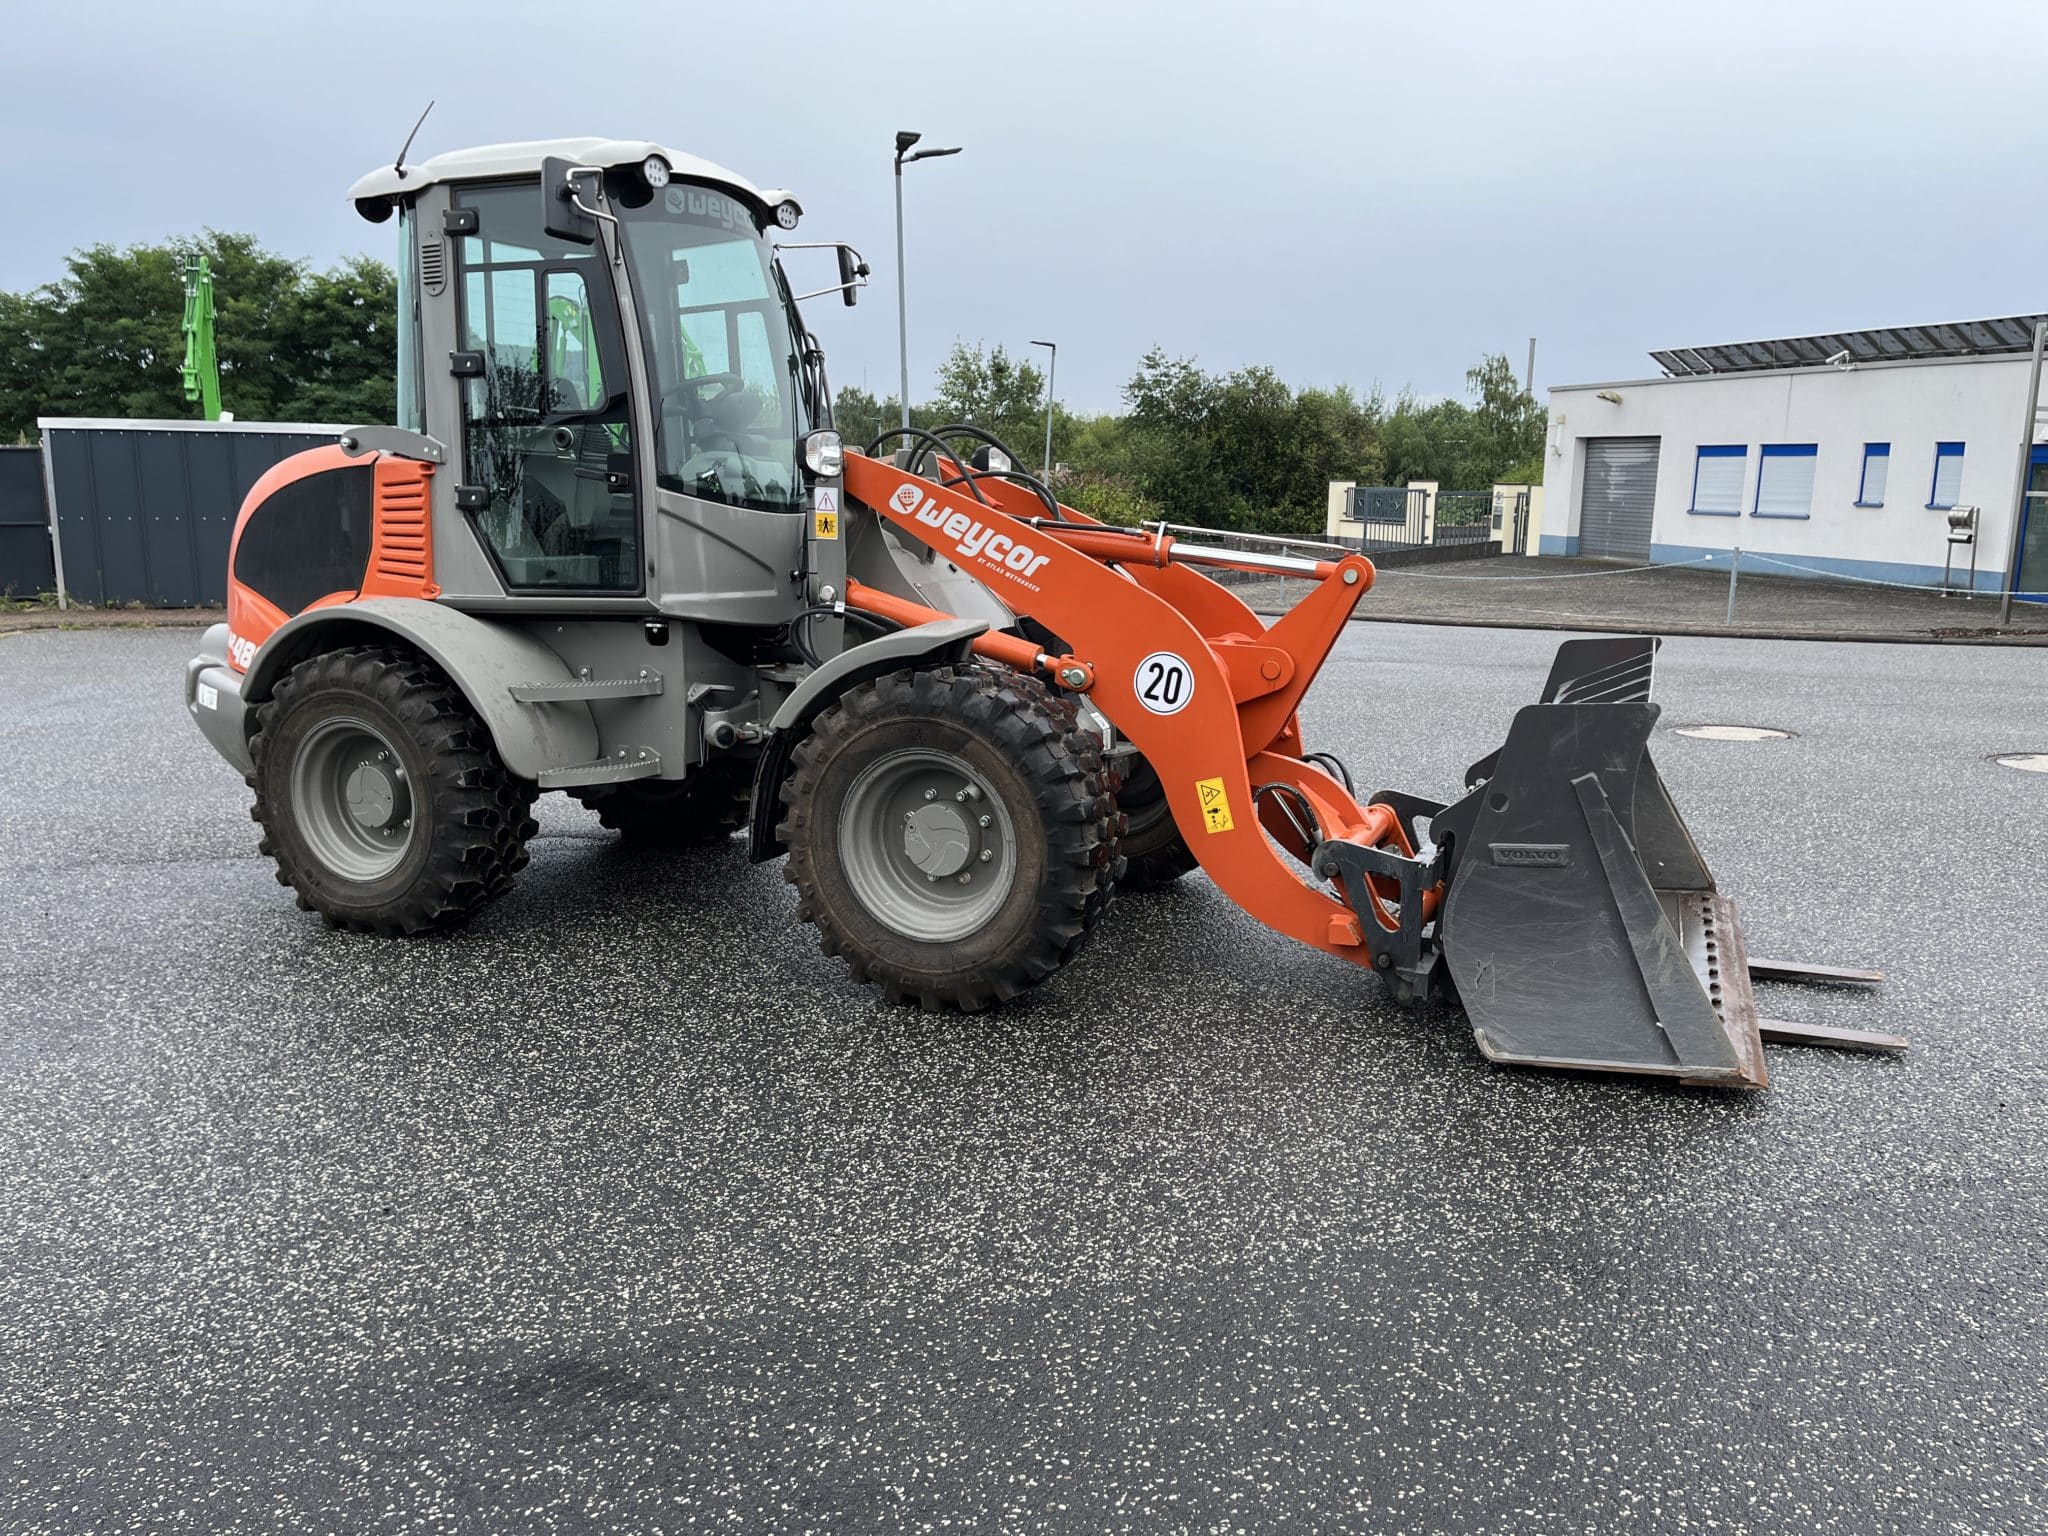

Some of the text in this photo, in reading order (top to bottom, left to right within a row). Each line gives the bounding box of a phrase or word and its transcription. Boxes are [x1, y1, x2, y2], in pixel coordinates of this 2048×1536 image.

[914, 498, 1051, 577] weycor
[976, 557, 1041, 593] BY ATLAS WEYHAUSEN
[1143, 662, 1183, 705] 20
[1498, 850, 1560, 861] VOLVO
